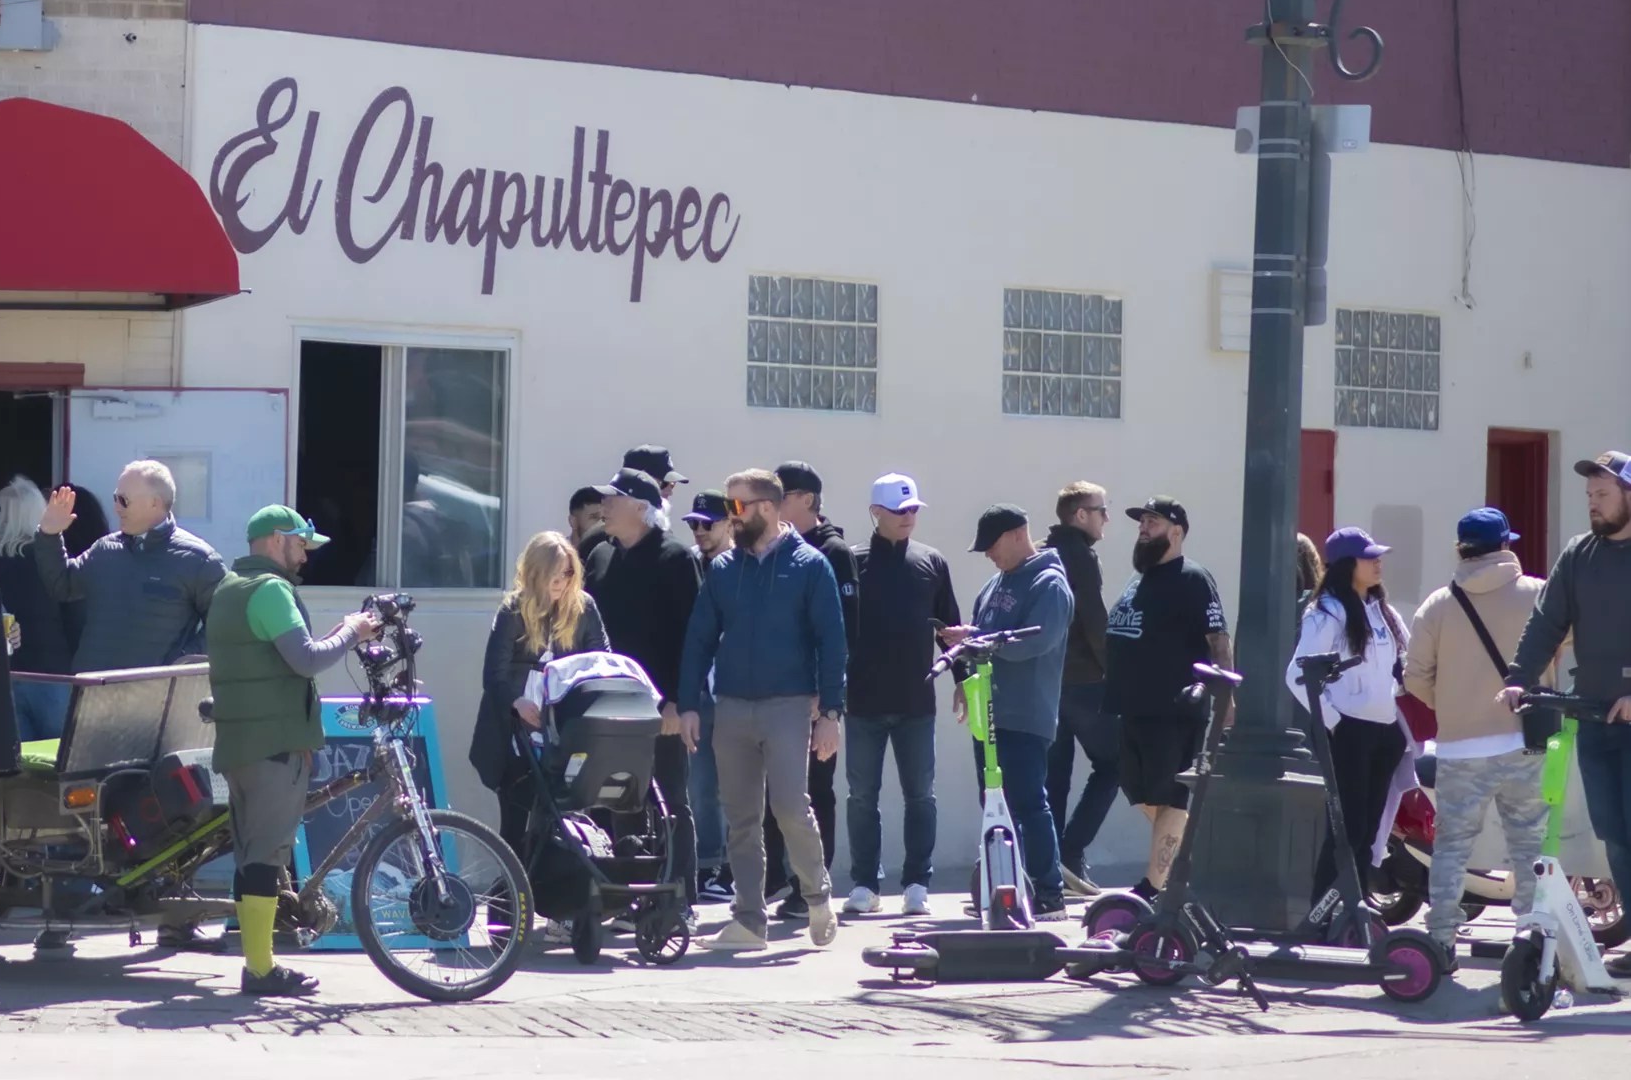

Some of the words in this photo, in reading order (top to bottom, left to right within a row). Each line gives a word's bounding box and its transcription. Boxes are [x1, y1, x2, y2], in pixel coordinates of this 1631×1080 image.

[209, 76, 323, 254] El
[334, 85, 740, 302] Chapultepec
[311, 743, 370, 782] JAZ
